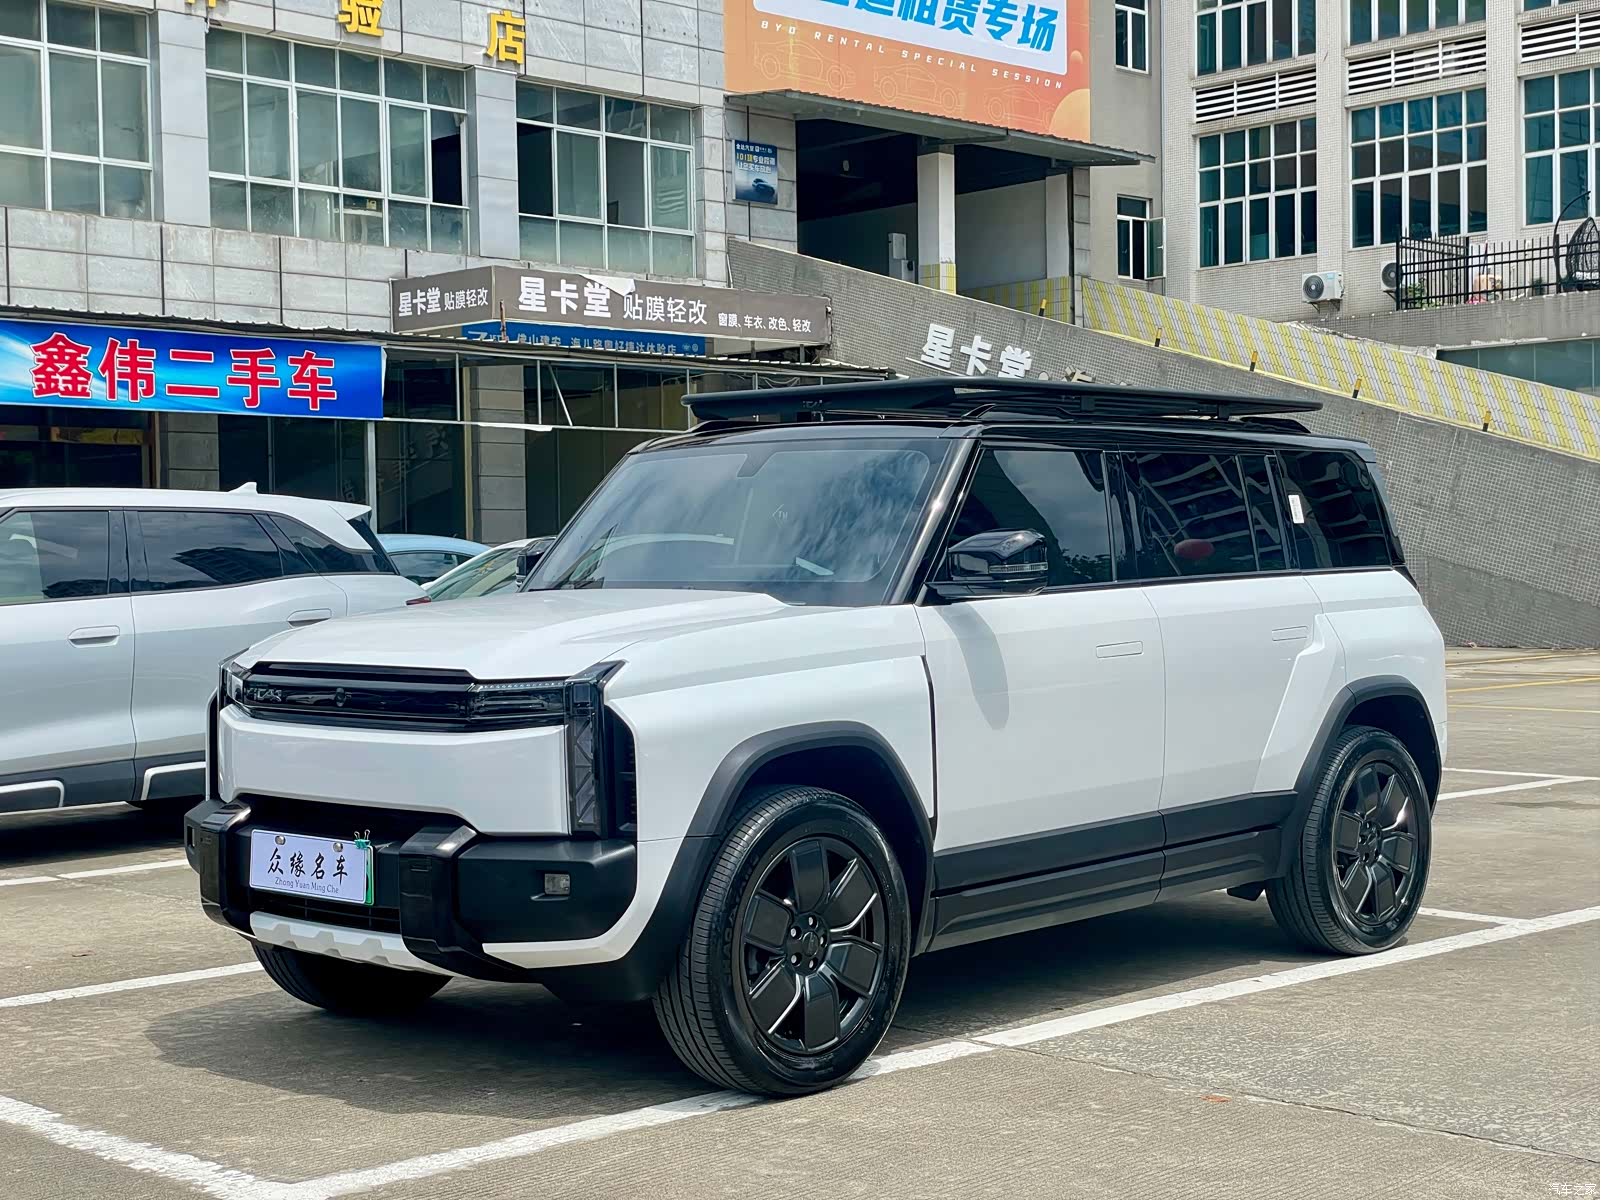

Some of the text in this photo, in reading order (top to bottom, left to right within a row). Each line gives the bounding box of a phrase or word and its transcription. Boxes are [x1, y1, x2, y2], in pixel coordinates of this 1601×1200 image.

[761, 20, 1062, 89] BYD RENTAL SPECIAL SESSION
[398, 287, 489, 317] 星卡堂 贴膜轻改
[518, 276, 612, 318] 星卡堂
[623, 294, 708, 325] 贴膜轻改
[29, 331, 338, 411] 鑫伟二手车
[267, 846, 348, 885] 众缘名车
[275, 876, 339, 894] Zhong Yuan Ming Che
